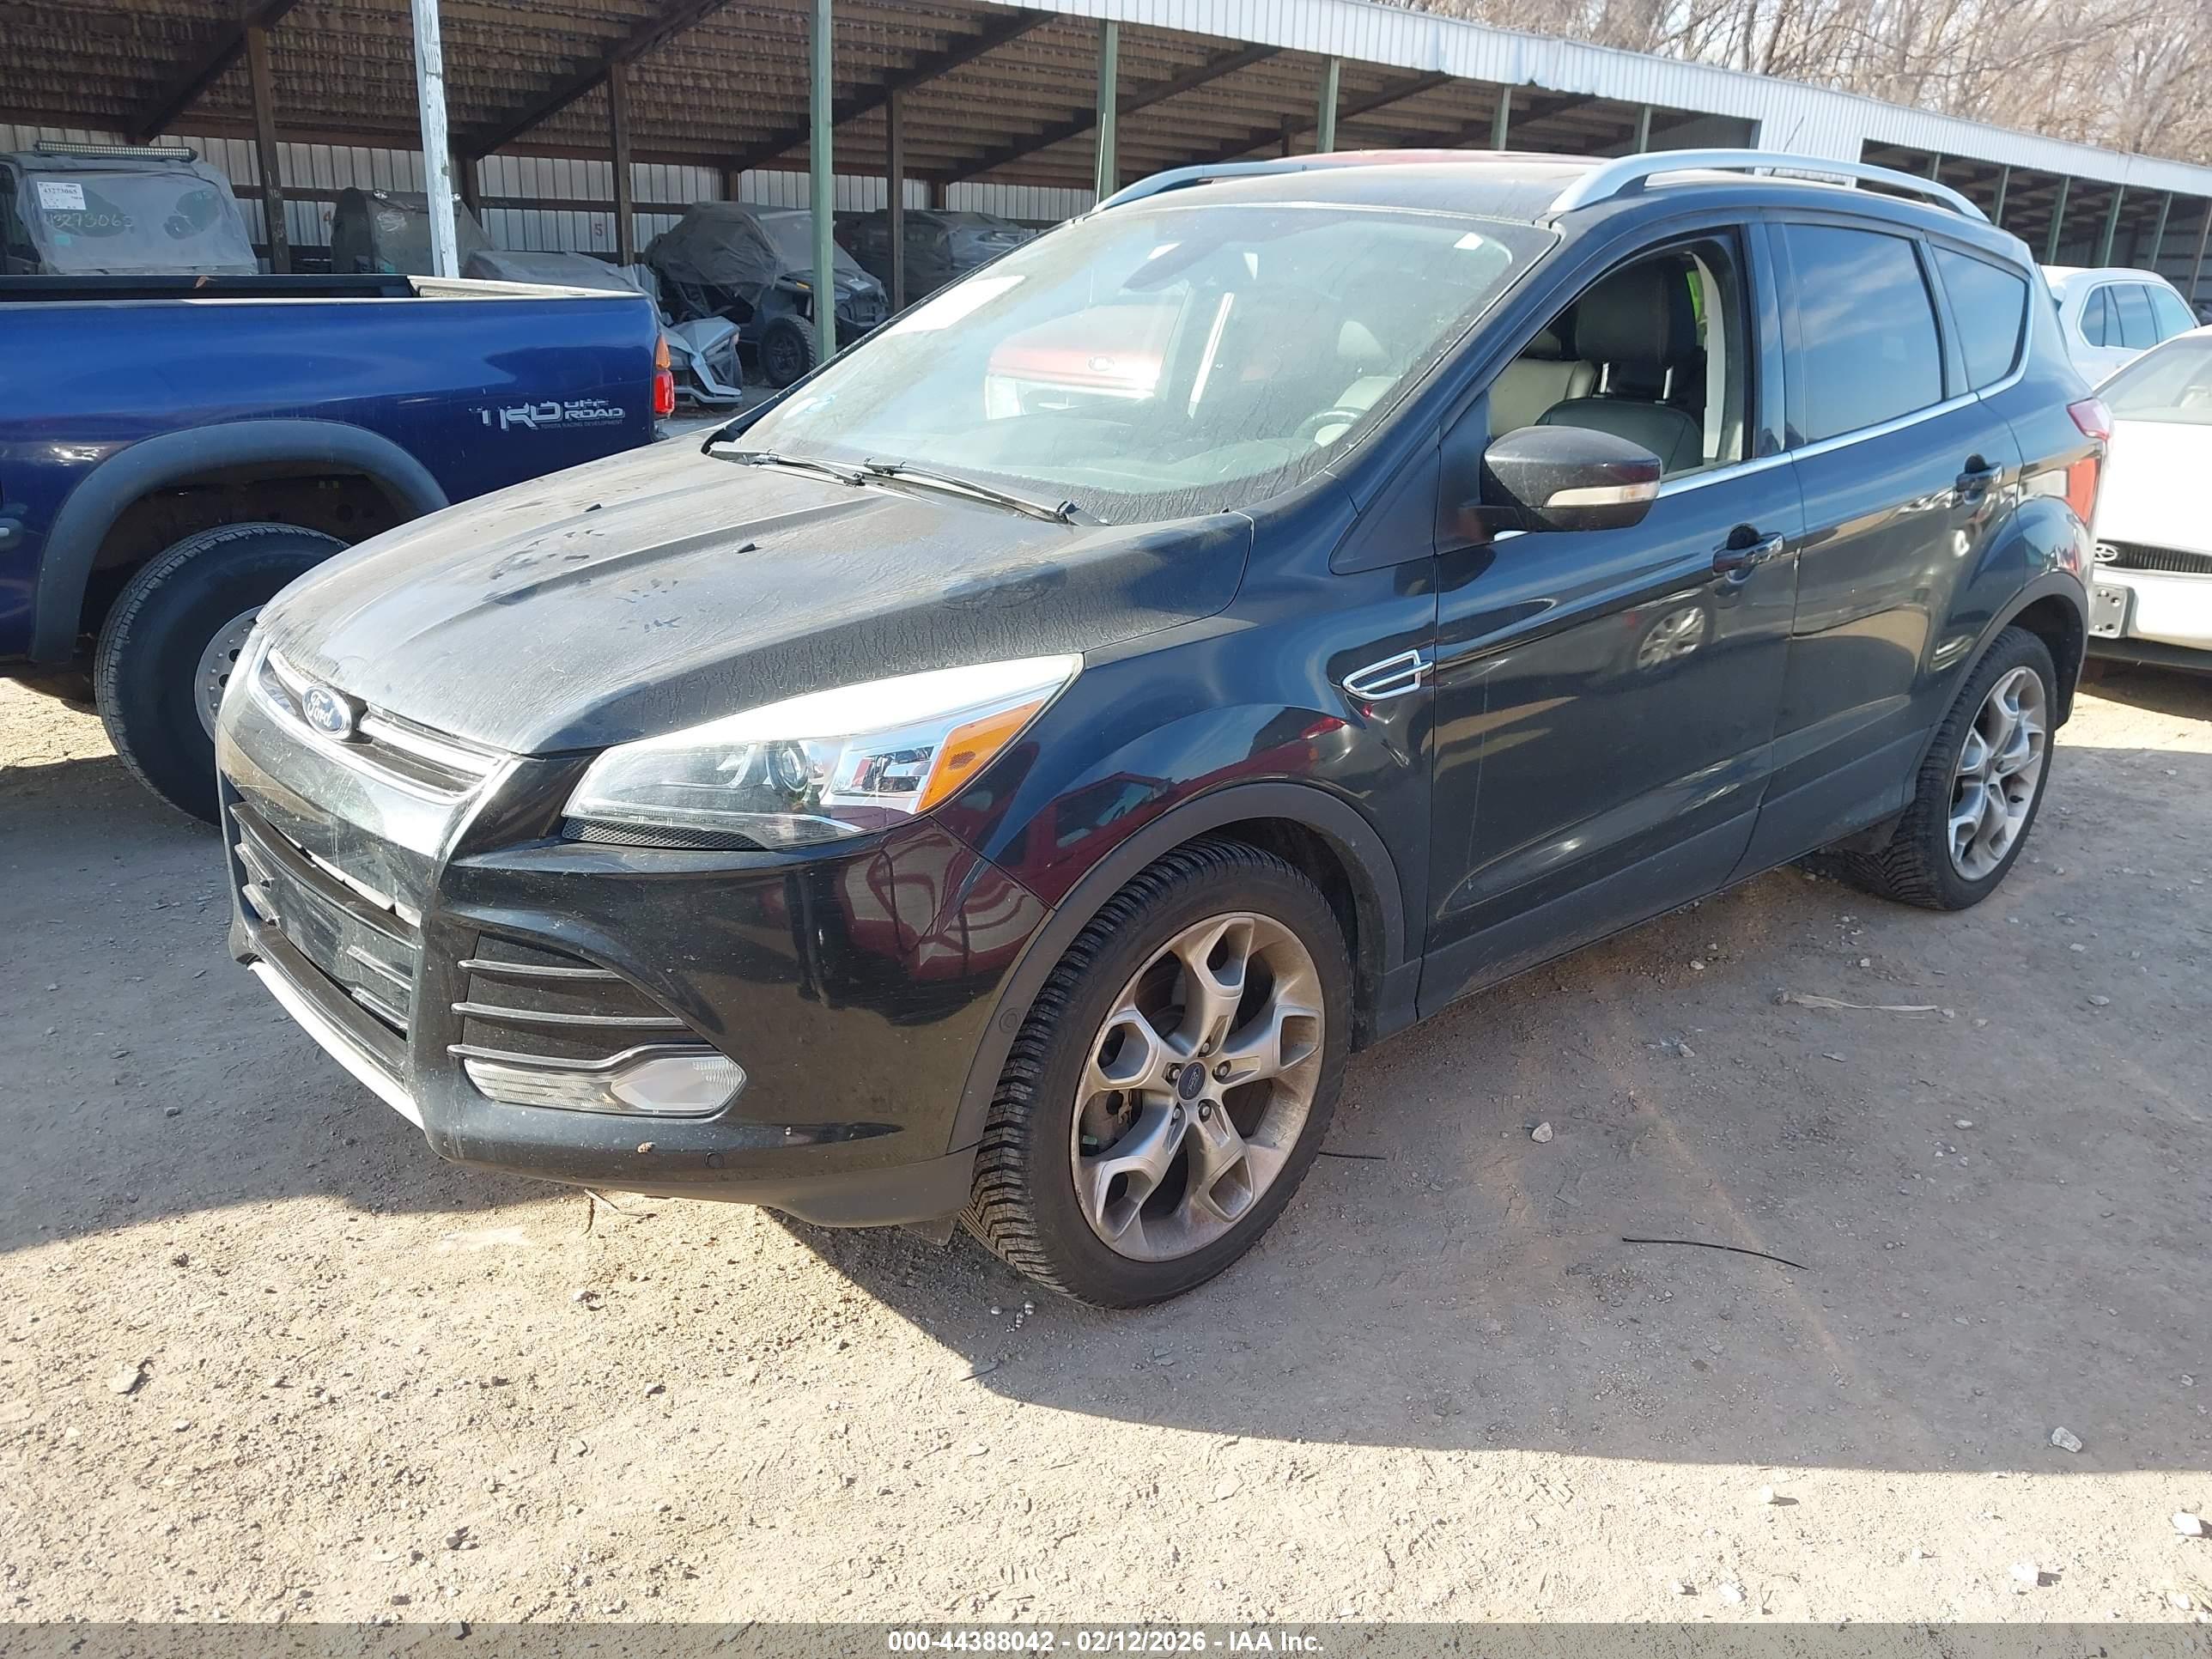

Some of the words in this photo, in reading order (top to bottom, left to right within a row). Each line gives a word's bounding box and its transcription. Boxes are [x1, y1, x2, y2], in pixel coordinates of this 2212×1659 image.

[595, 223, 603, 236] 5
[564, 407, 625, 420] ROAD
[307, 690, 335, 727] Ford
